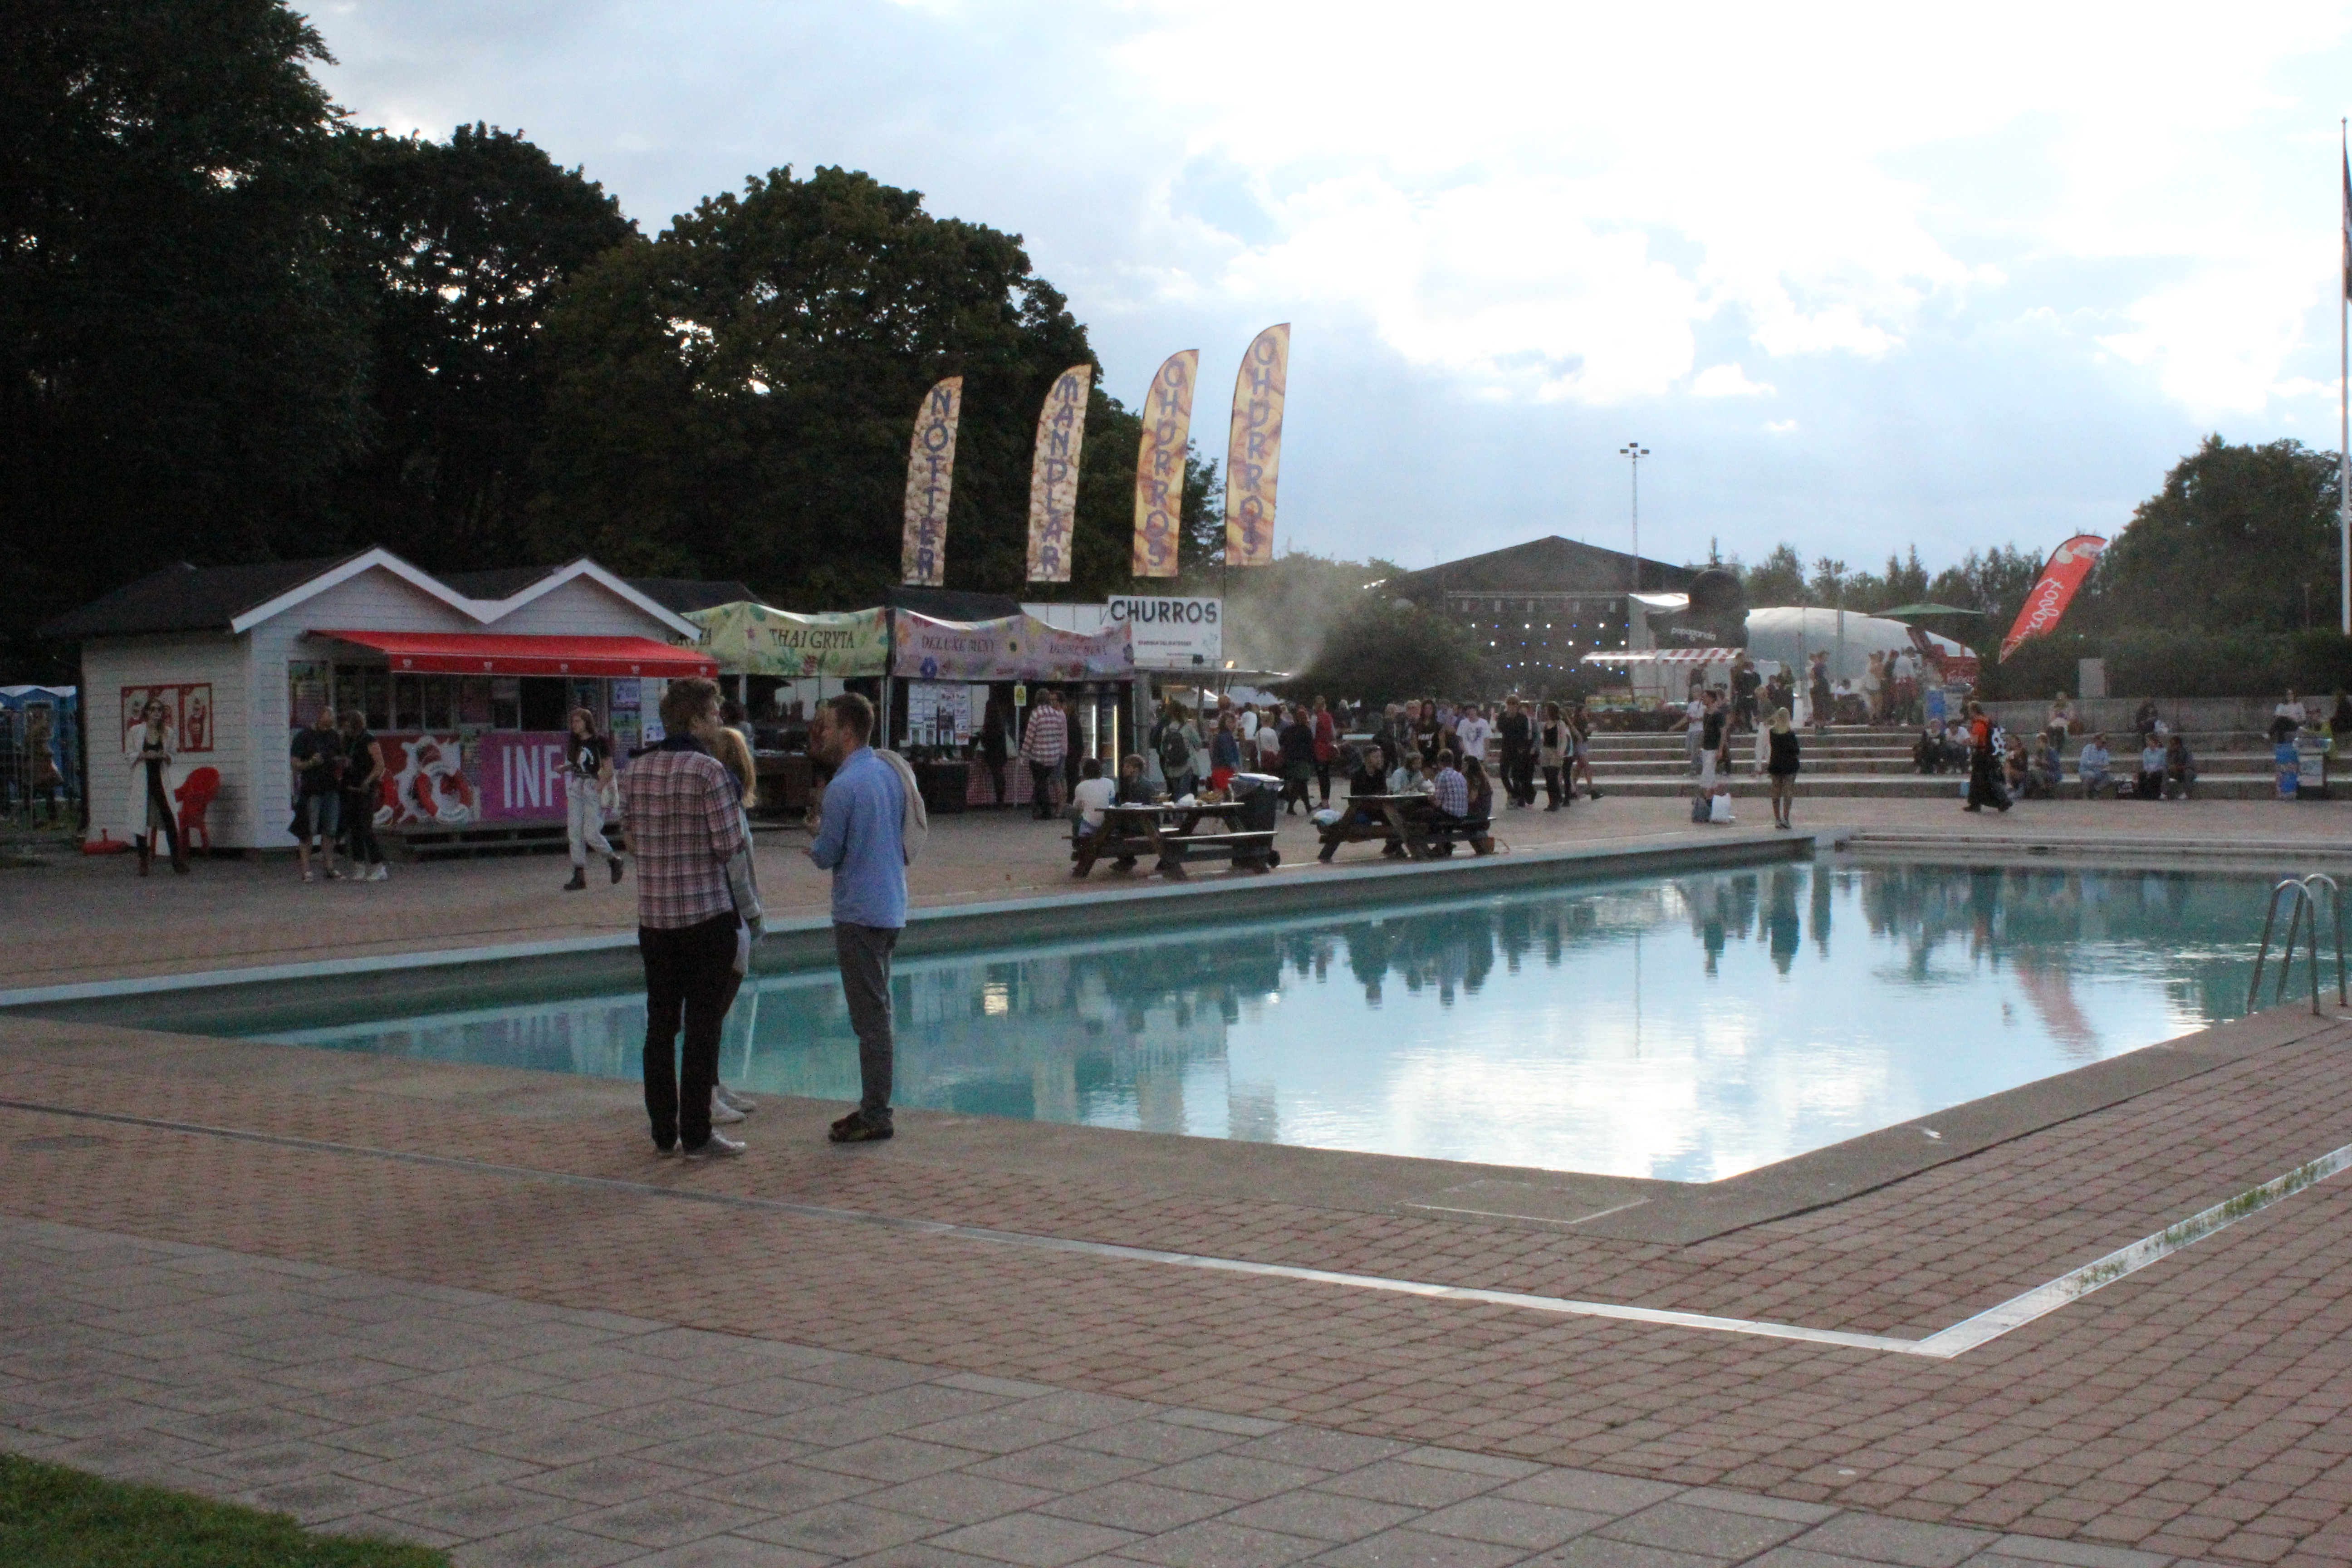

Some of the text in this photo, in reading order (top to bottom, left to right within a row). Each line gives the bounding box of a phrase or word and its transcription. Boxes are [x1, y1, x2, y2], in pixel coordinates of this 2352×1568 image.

[918, 387, 951, 579] NÖTTER
[1042, 375, 1078, 572] MANDLAR
[1146, 360, 1186, 566] CHURROS
[1240, 336, 1277, 555] CHURROS
[769, 628, 855, 648] THAI GRYTA
[1111, 600, 1217, 623] CHURROS
[503, 745, 573, 808] INF
